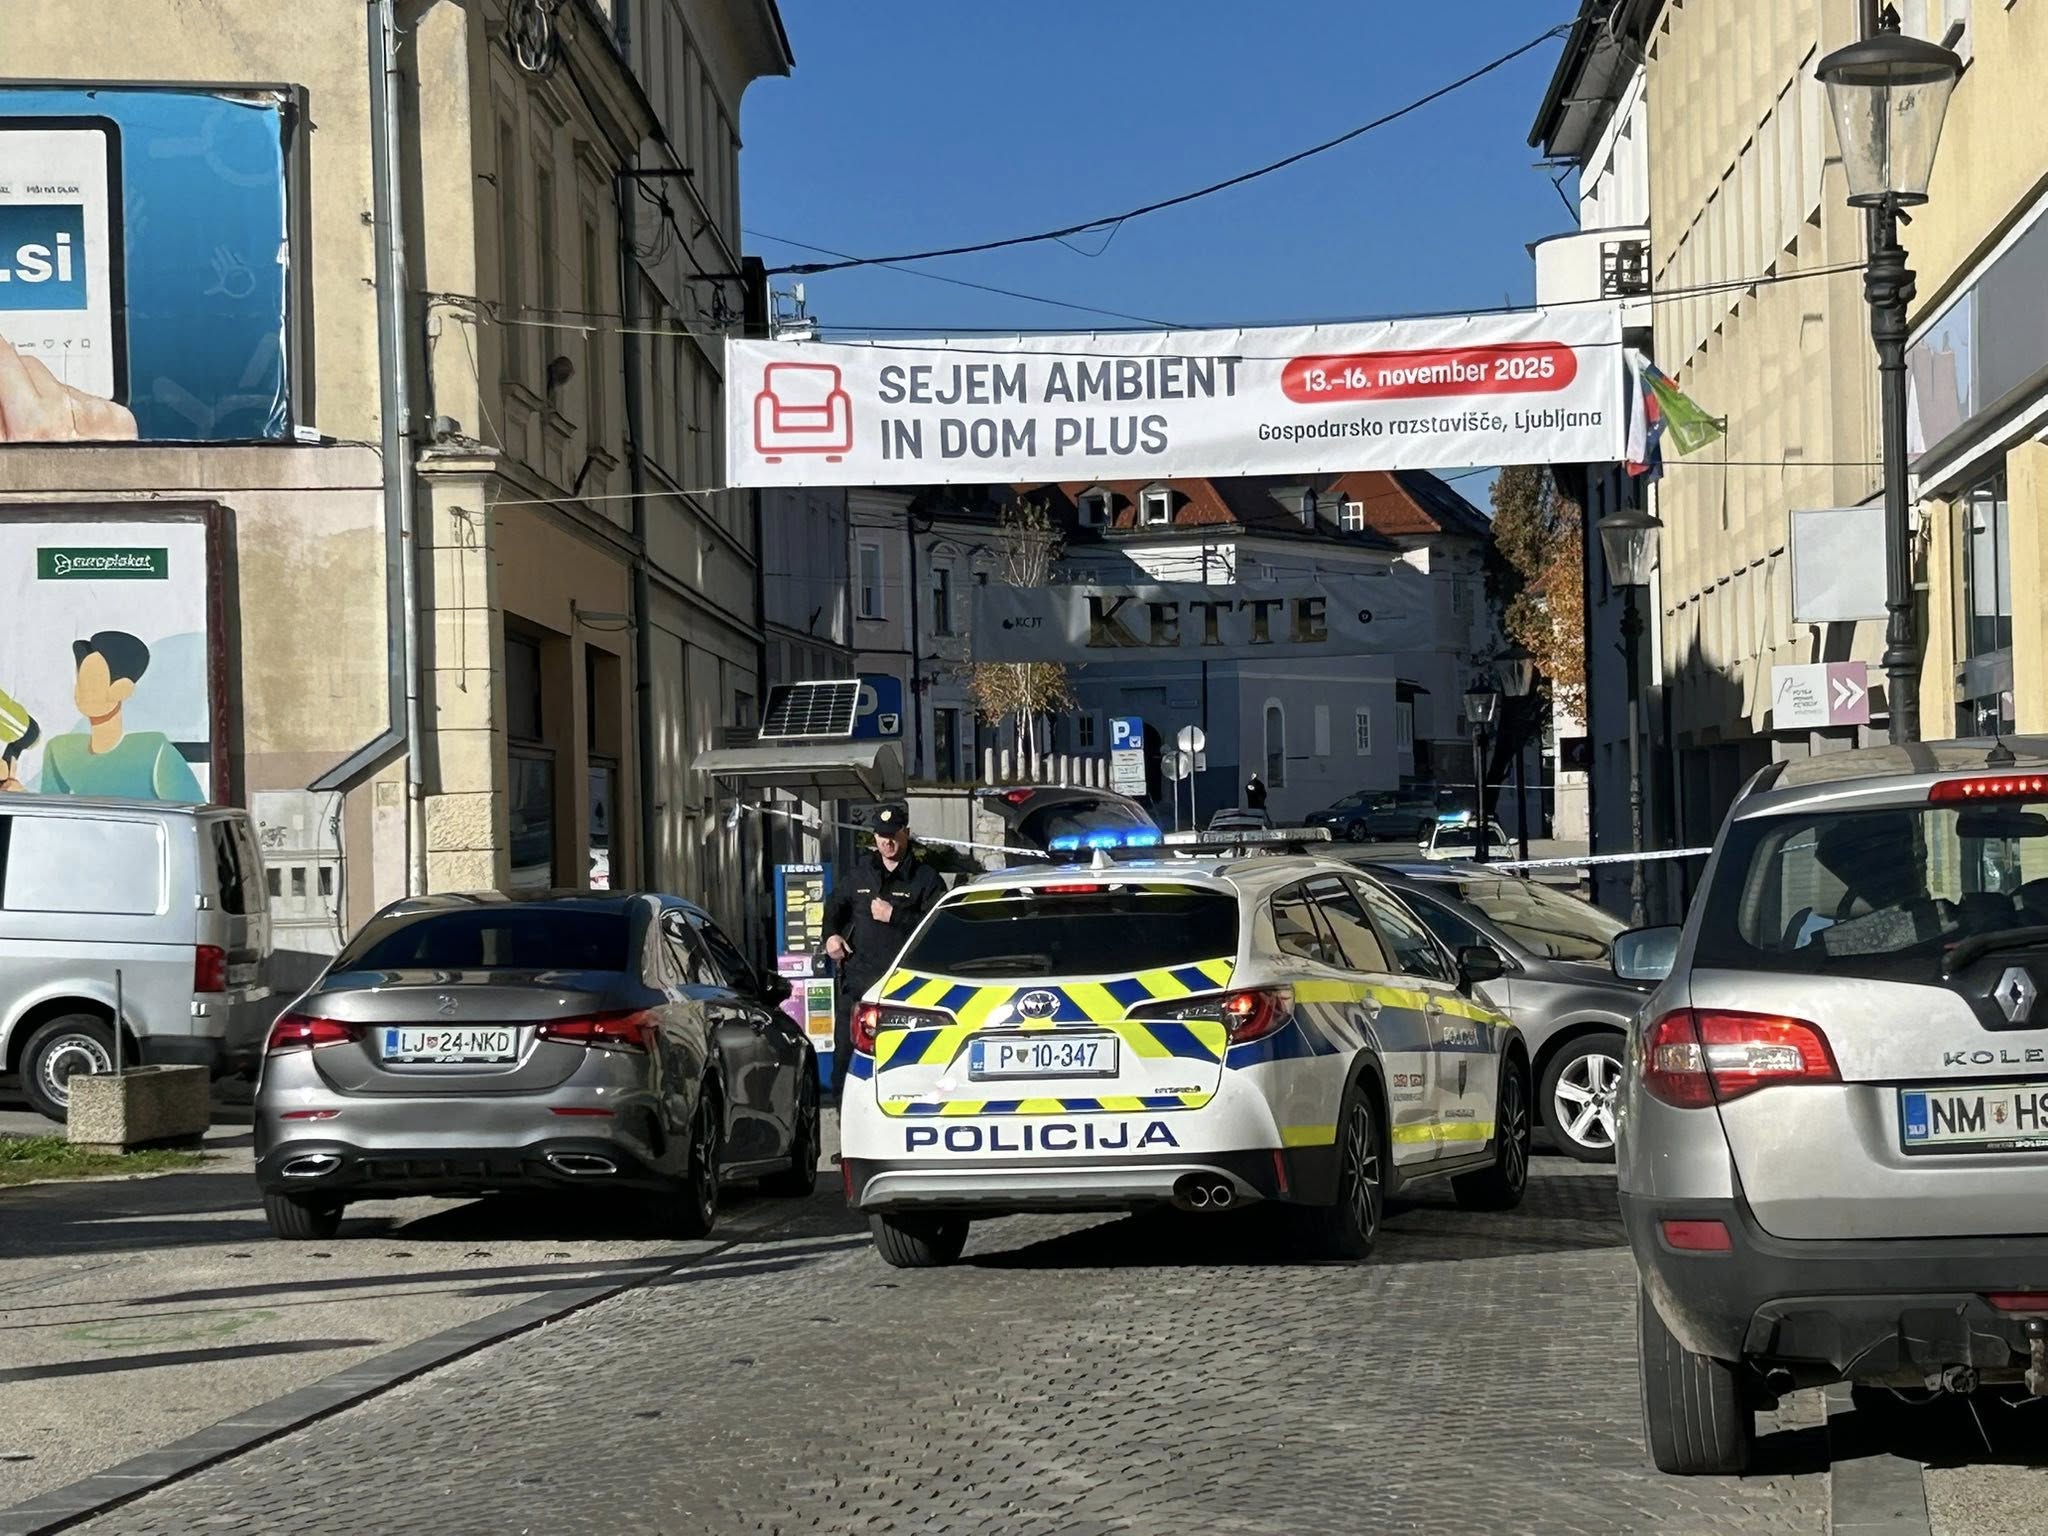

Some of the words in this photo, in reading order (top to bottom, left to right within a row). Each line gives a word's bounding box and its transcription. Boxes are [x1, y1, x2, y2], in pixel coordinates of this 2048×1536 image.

[879, 364, 1027, 404] SEJEM
[1043, 356, 1242, 403] AMBIENT
[1378, 360, 1488, 388] november
[1495, 356, 1555, 381] 2025
[881, 419, 923, 460] IN
[940, 418, 1036, 459] DOM
[1055, 415, 1169, 457] PLUS
[1258, 417, 1383, 443] Gospodarsko
[1389, 411, 1508, 435] razstavišče,
[1515, 407, 1603, 433] Ljubljana
[1083, 597, 1328, 648] KETTE
[1113, 721, 1130, 745] P
[402, 1032, 425, 1052] LJ
[440, 1032, 509, 1052] 24-NKD
[1000, 1045, 1013, 1068] P
[1035, 1043, 1098, 1068] 10-347
[1931, 1096, 1986, 1135] NM
[905, 1121, 1181, 1153] POLICIJA
